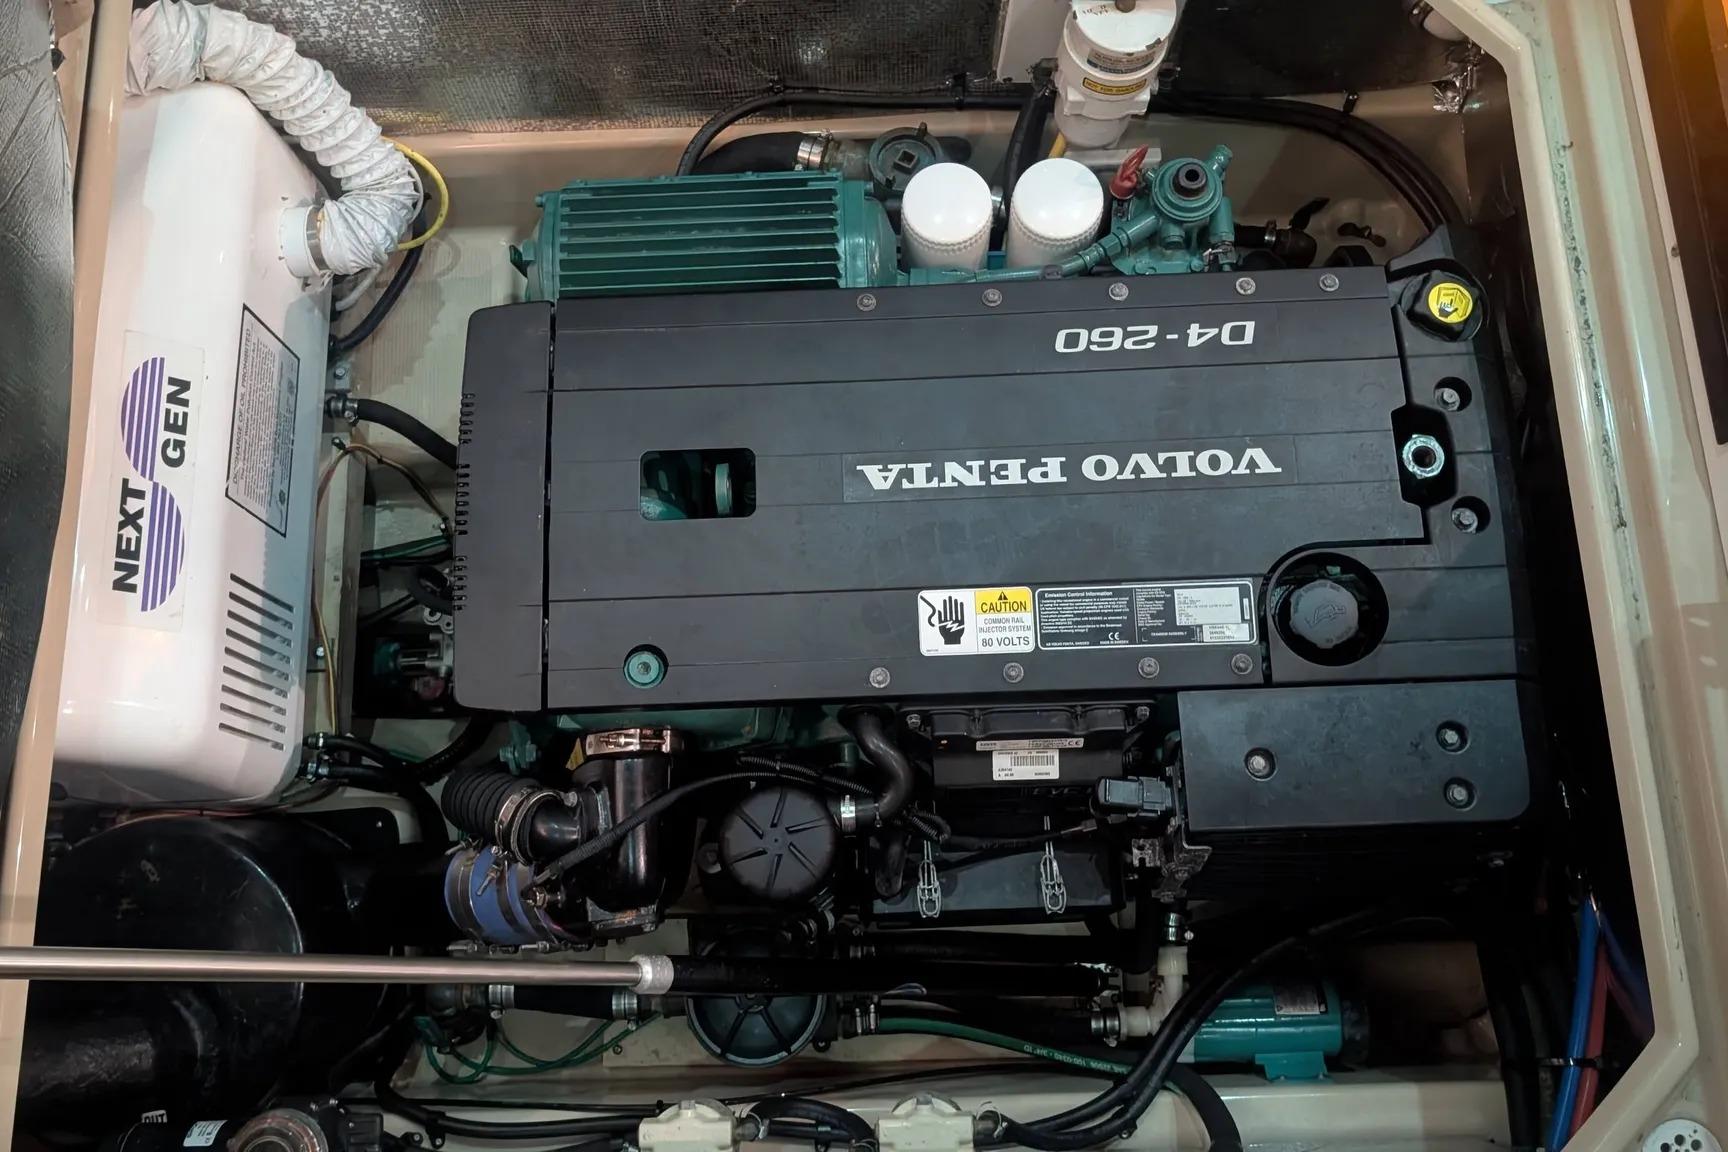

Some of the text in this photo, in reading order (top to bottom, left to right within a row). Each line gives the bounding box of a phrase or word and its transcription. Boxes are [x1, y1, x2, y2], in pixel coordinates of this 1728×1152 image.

[1054, 319, 1256, 354] D4-260
[240, 328, 251, 389] PROHIBITED
[161, 376, 192, 468] GEN
[856, 447, 1282, 490] VOLVO PENTA
[112, 477, 146, 594] NEXT
[980, 600, 1027, 613] CAUTION
[984, 616, 1025, 625] COMMON RAIL
[978, 626, 1007, 634] INJECTOR
[982, 636, 1031, 647] 80 VOLTS
